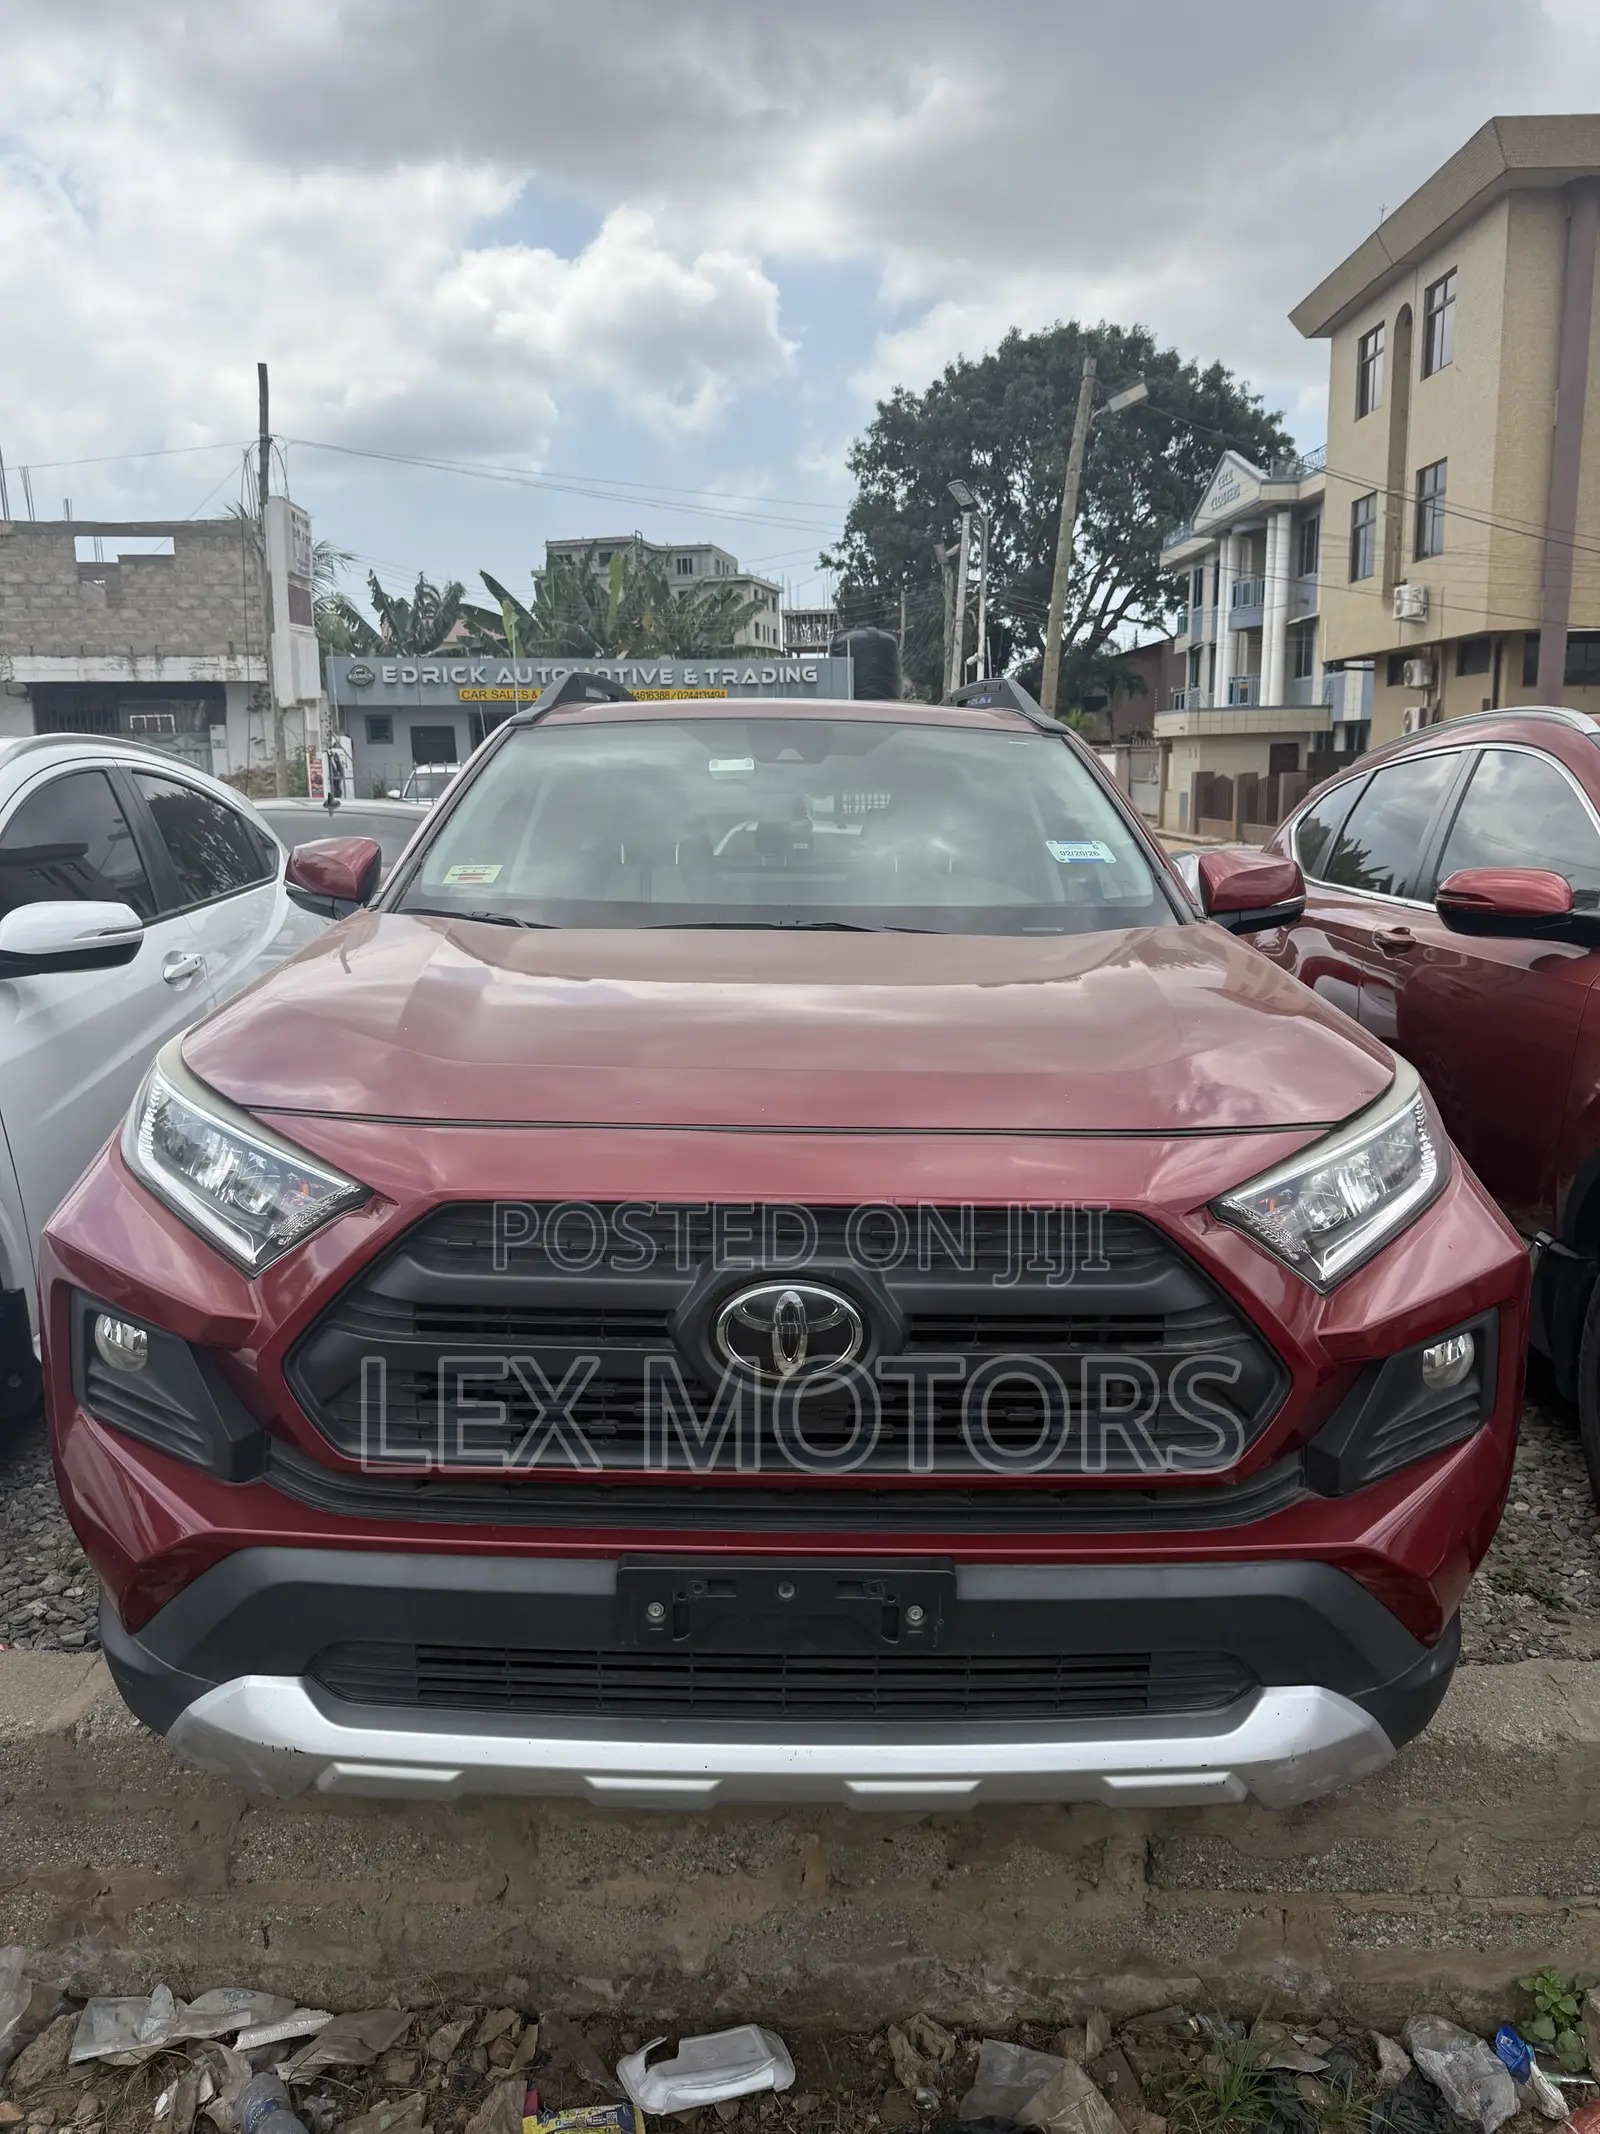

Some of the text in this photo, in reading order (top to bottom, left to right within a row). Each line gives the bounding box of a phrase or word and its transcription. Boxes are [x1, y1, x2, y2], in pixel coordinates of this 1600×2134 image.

[381, 666, 487, 684] EDRICK
[683, 667, 699, 684] &
[705, 666, 818, 684] TRADING
[461, 690, 487, 700] CAR
[491, 690, 529, 700] SALES
[531, 690, 538, 699] &
